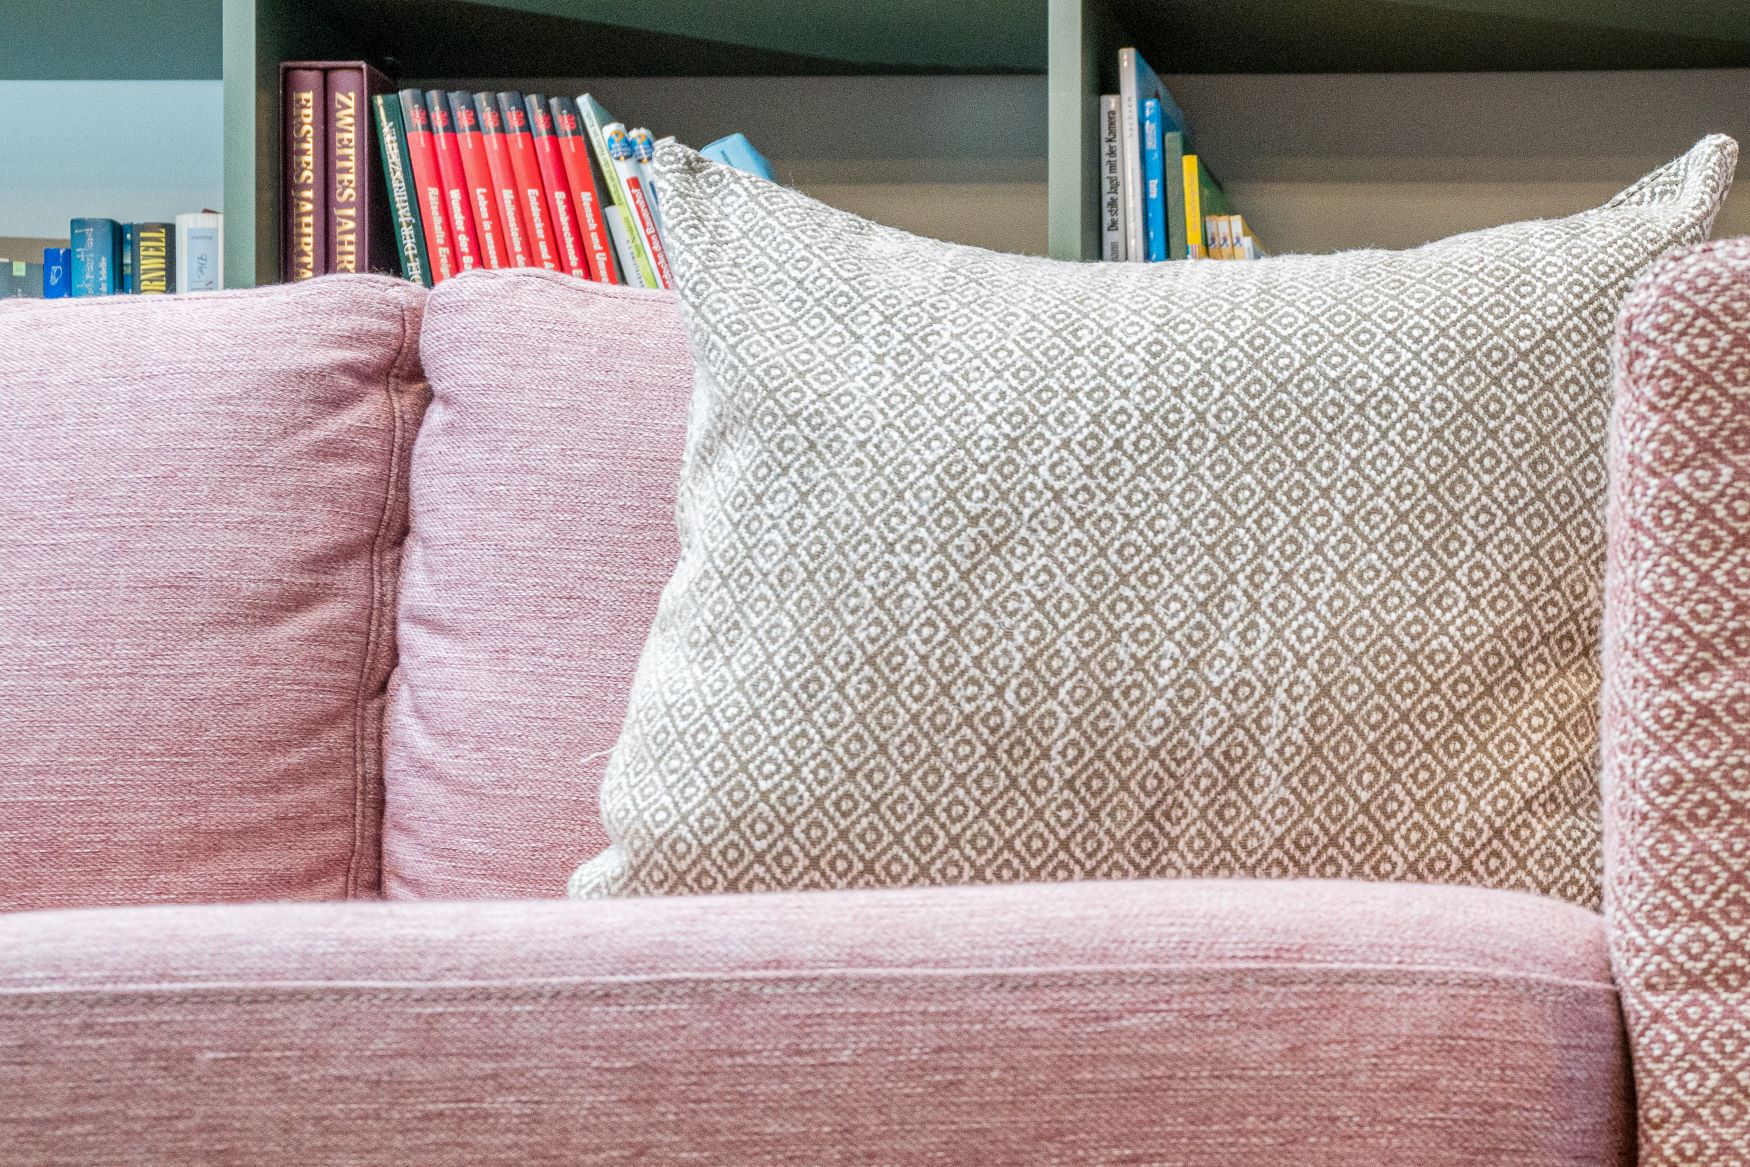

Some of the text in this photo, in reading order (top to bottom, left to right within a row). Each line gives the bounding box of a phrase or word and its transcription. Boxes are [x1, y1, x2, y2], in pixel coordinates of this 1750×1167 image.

[293, 91, 313, 185] ERSTES
[1105, 110, 1117, 142] Kamera
[1106, 143, 1117, 158] der
[1106, 159, 1118, 173] mit
[334, 91, 356, 273] ZWEITES JAHR
[1106, 175, 1120, 195] Jagd
[449, 188, 466, 233] Wunder
[475, 187, 489, 220] Leben
[502, 188, 522, 253] Meilensteine
[580, 191, 597, 231] Mensch
[590, 231, 604, 251] und
[1107, 195, 1119, 216] stille
[399, 225, 419, 256] DER
[527, 188, 545, 240] Entdecker
[538, 240, 552, 260] und
[554, 190, 578, 268] Bahnbrechende
[1107, 217, 1119, 231] Die
[140, 228, 166, 293] RNWELL
